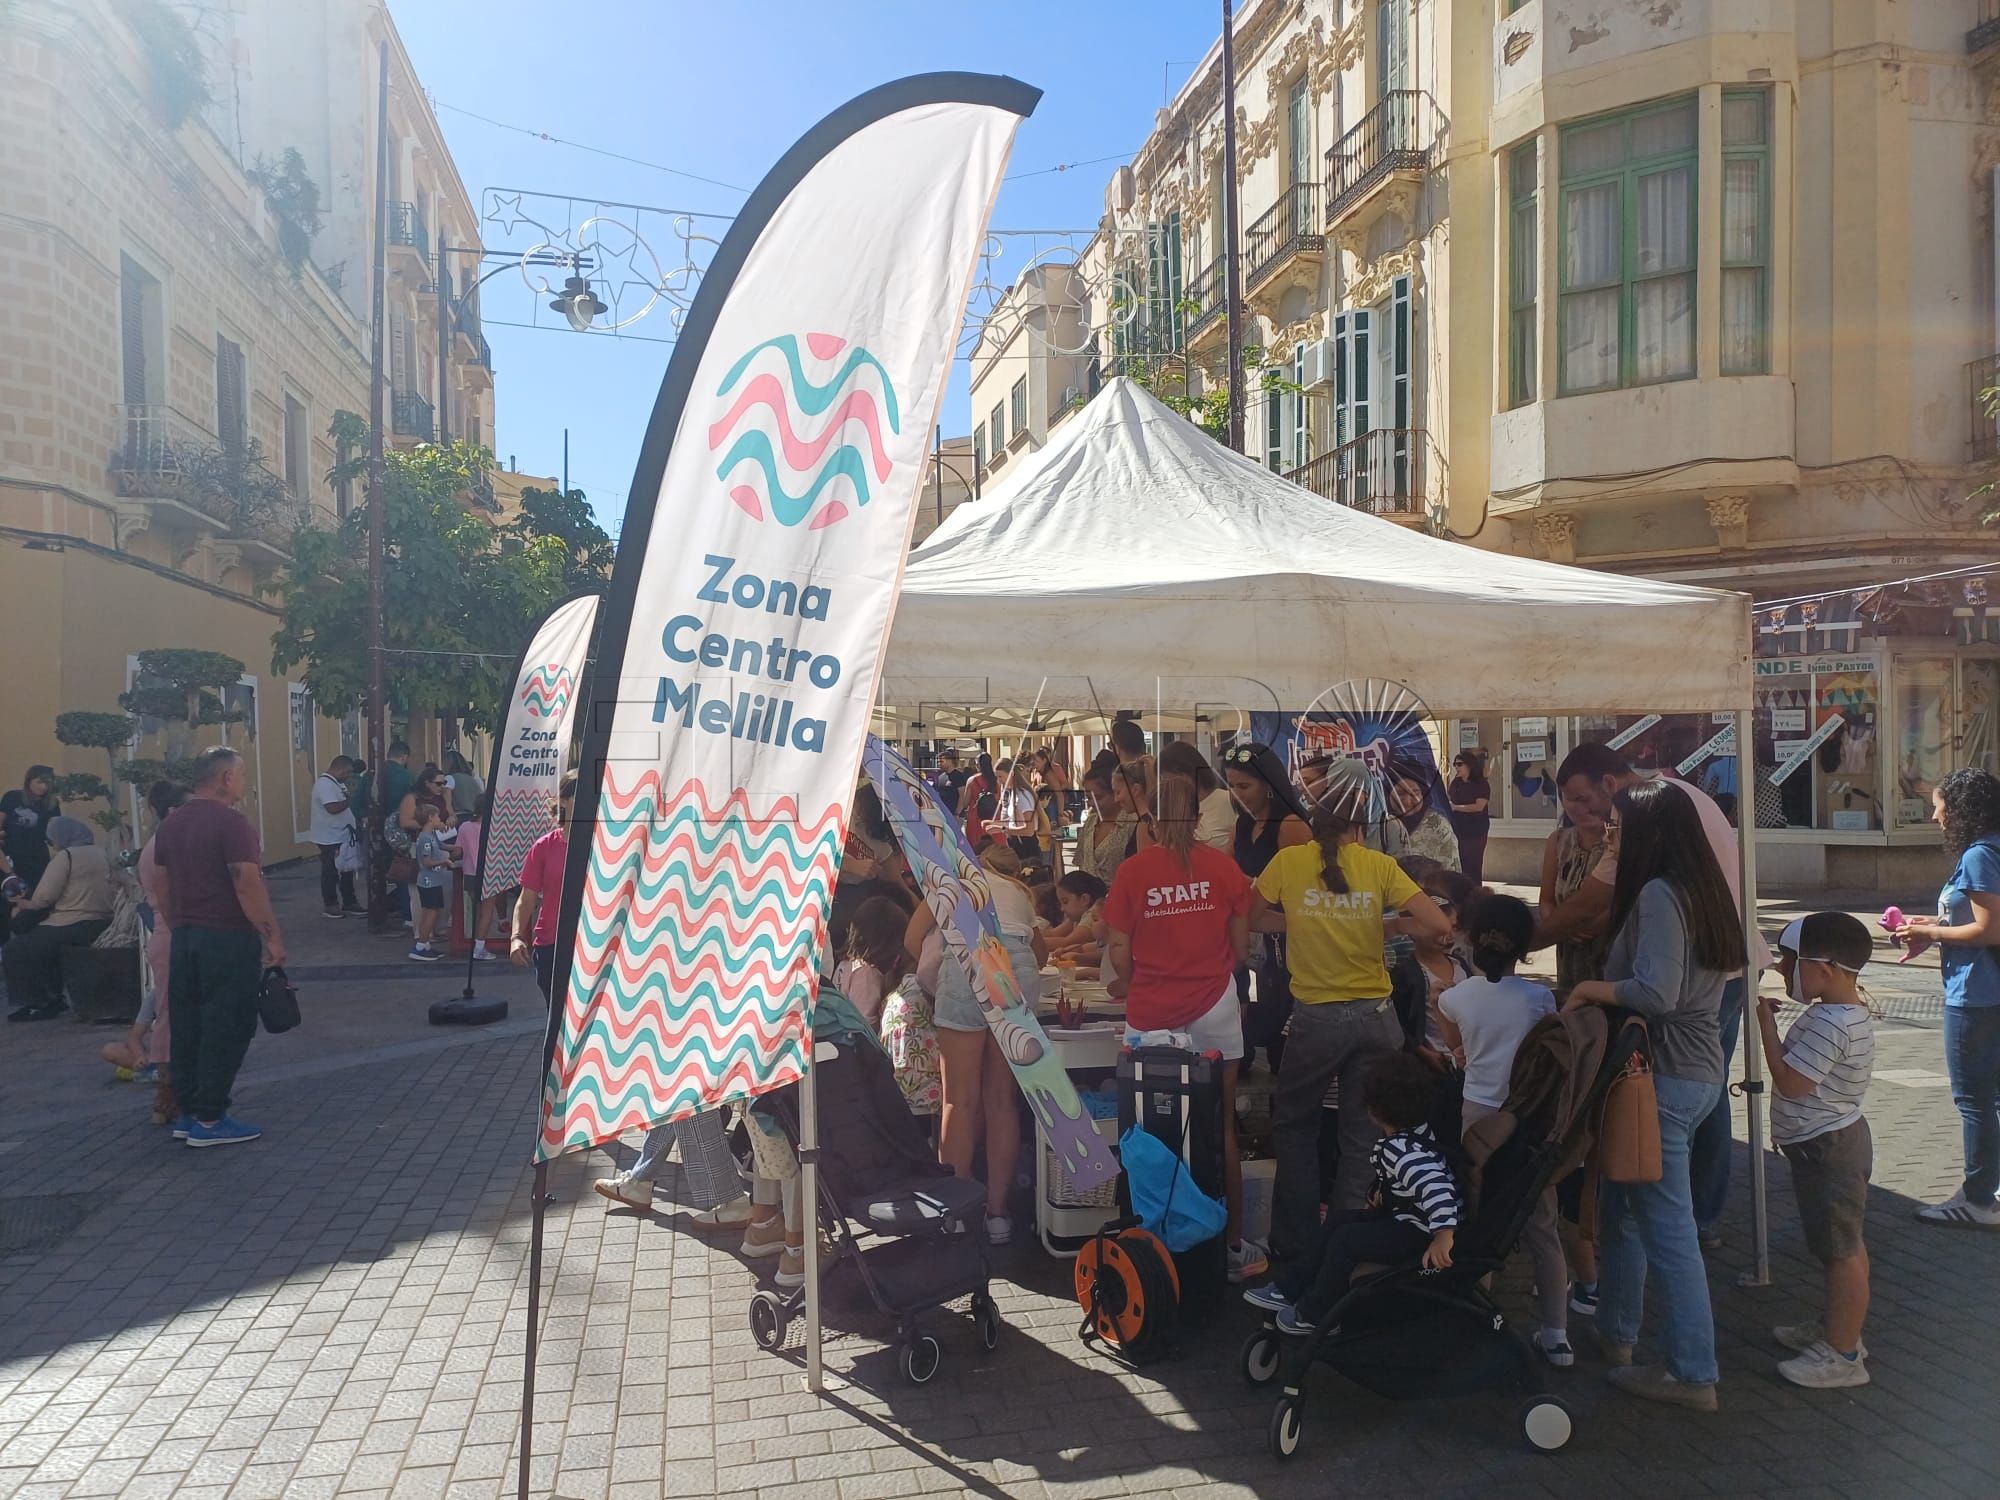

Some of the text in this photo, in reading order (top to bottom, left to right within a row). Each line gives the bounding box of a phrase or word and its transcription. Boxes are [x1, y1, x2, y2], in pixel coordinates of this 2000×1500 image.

[696, 553, 832, 622] Zona
[661, 614, 841, 689] Centro
[1752, 660, 1802, 674] NDE
[1835, 661, 1875, 671] PASTOR
[651, 676, 828, 753] Melilla
[520, 727, 557, 741] Zona
[510, 744, 559, 759] Centro
[509, 762, 556, 777] Melilla
[1146, 881, 1210, 907] STAFF
[1303, 887, 1373, 909] STAFF
